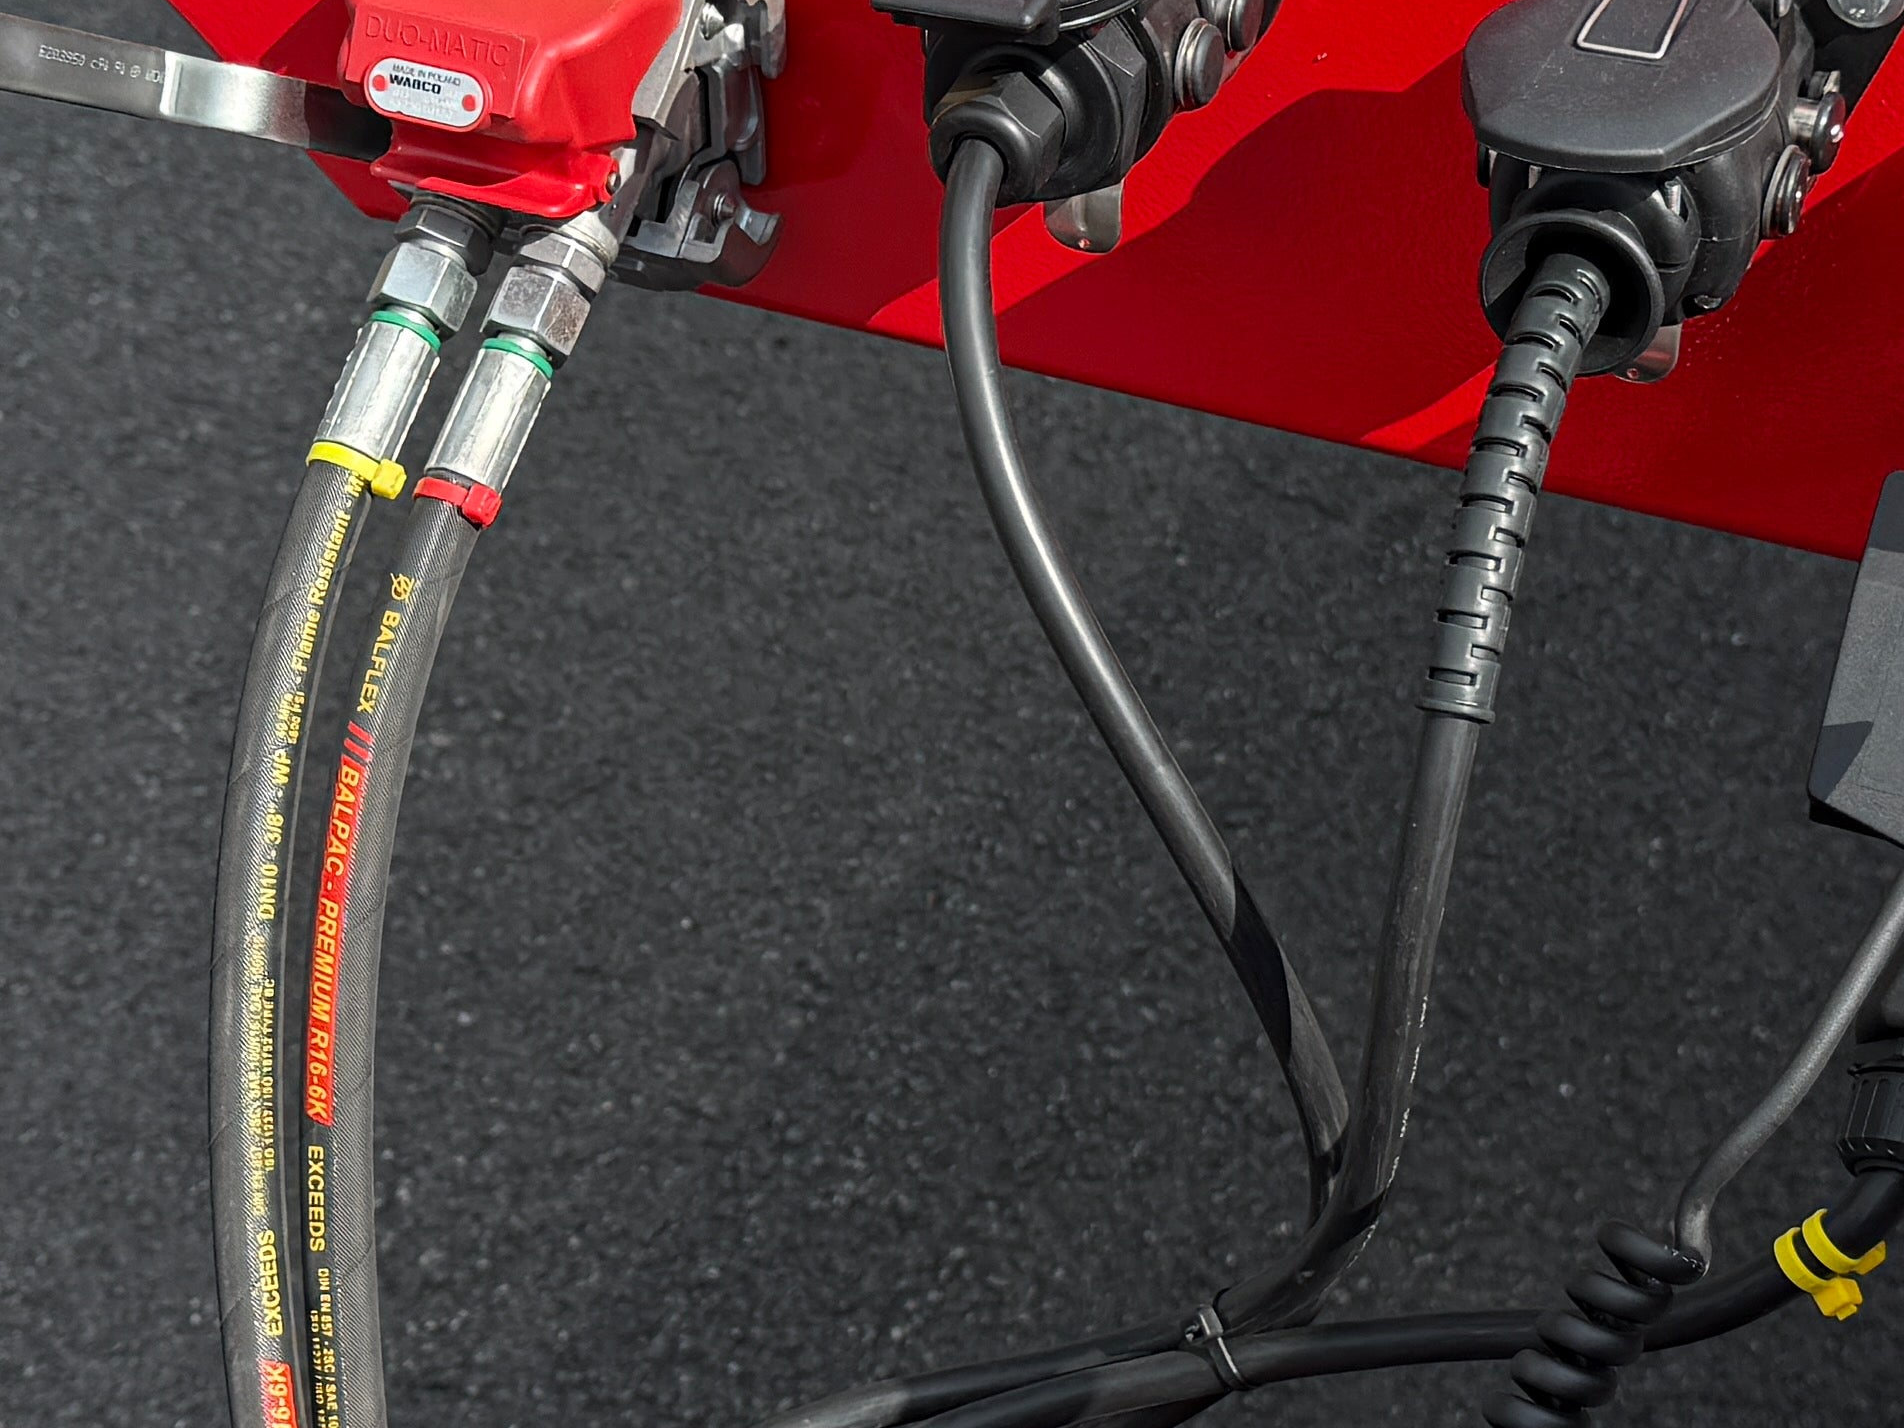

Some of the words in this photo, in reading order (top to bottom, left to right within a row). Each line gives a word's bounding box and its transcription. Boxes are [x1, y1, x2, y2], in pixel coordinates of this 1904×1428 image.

[365, 15, 511, 68] DUO-MATIC
[389, 73, 442, 95] WABCO
[291, 607, 321, 673] Flame
[356, 609, 402, 715] BALFLEX
[325, 763, 361, 878] BALPAC
[257, 863, 279, 921] DN10
[309, 896, 340, 1024] PREMIUM
[307, 1026, 330, 1120] R16-6K
[307, 1144, 326, 1254] EXCEEDS
[256, 1229, 284, 1338] EXCEEDS
